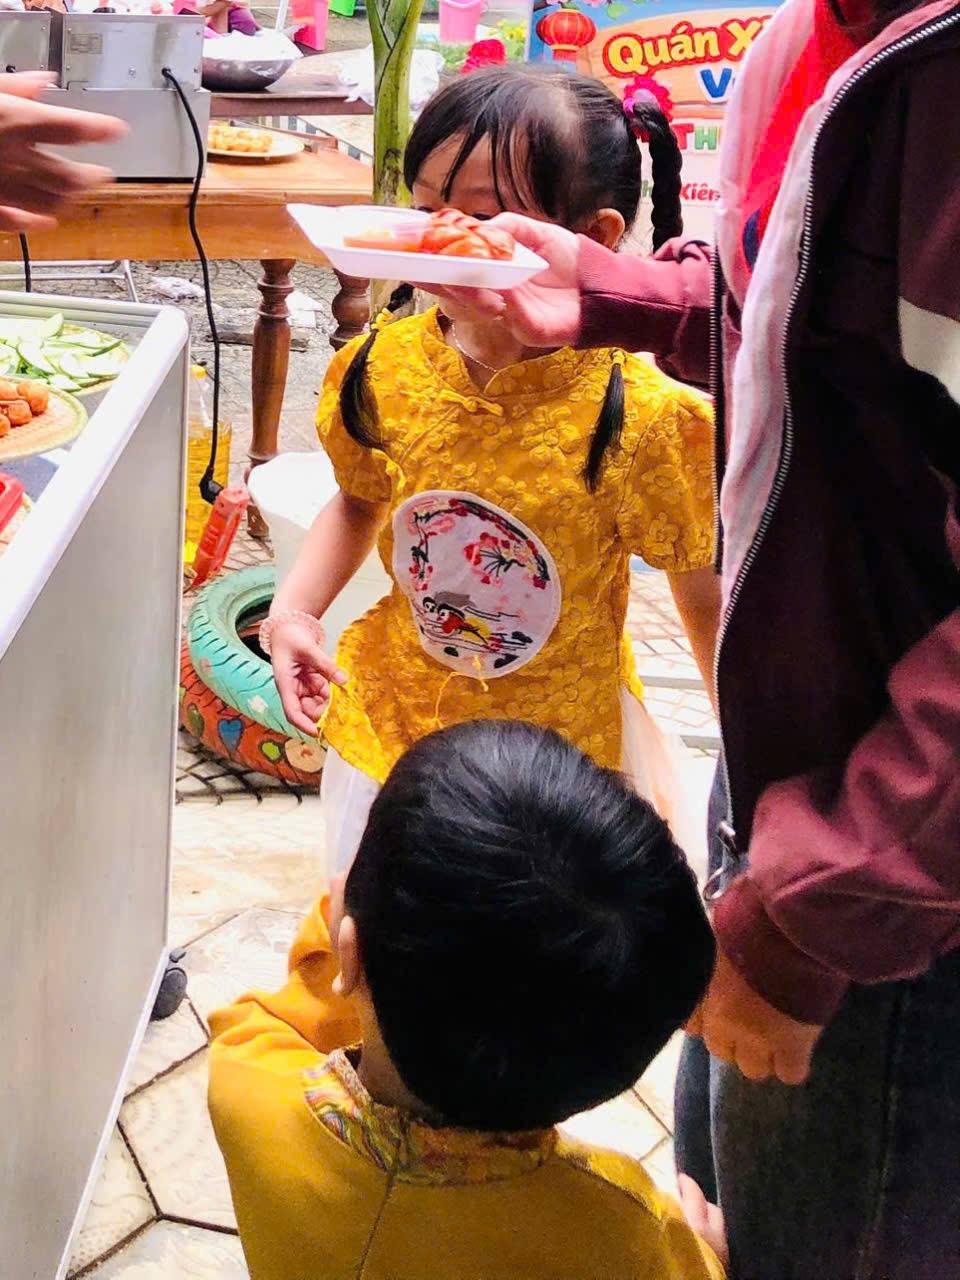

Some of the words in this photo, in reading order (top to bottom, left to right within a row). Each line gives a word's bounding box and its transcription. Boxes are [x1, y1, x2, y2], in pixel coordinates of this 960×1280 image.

[608, 25, 720, 75] Quán
[727, 21, 766, 56] X
[700, 68, 736, 98] V
[672, 123, 721, 150] TH
